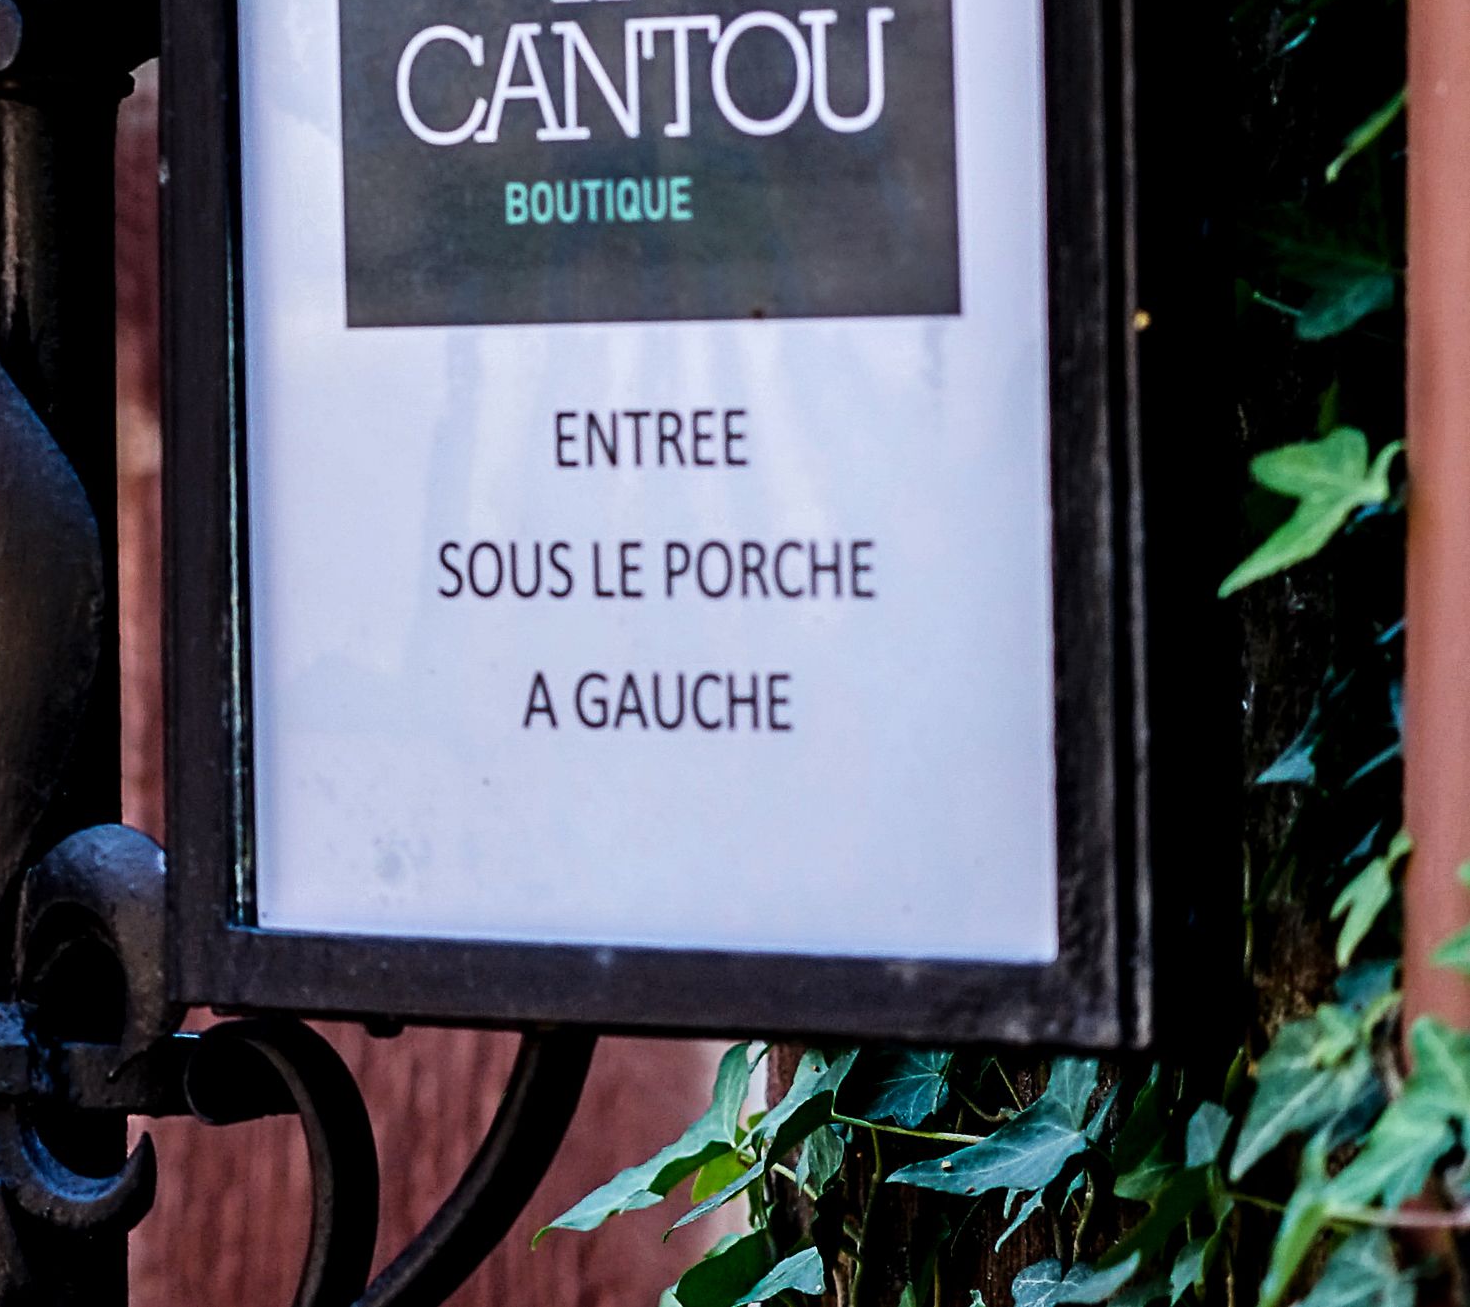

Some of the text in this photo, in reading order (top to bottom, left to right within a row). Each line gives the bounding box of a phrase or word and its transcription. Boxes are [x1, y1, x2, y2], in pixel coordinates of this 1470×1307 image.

[397, 7, 894, 145] CANTOU
[506, 178, 693, 224] BOUTIQUE
[556, 410, 748, 467] ENTREE
[439, 540, 876, 598] SOUS LE PORCHE
[524, 672, 793, 730] A GAUCHE
